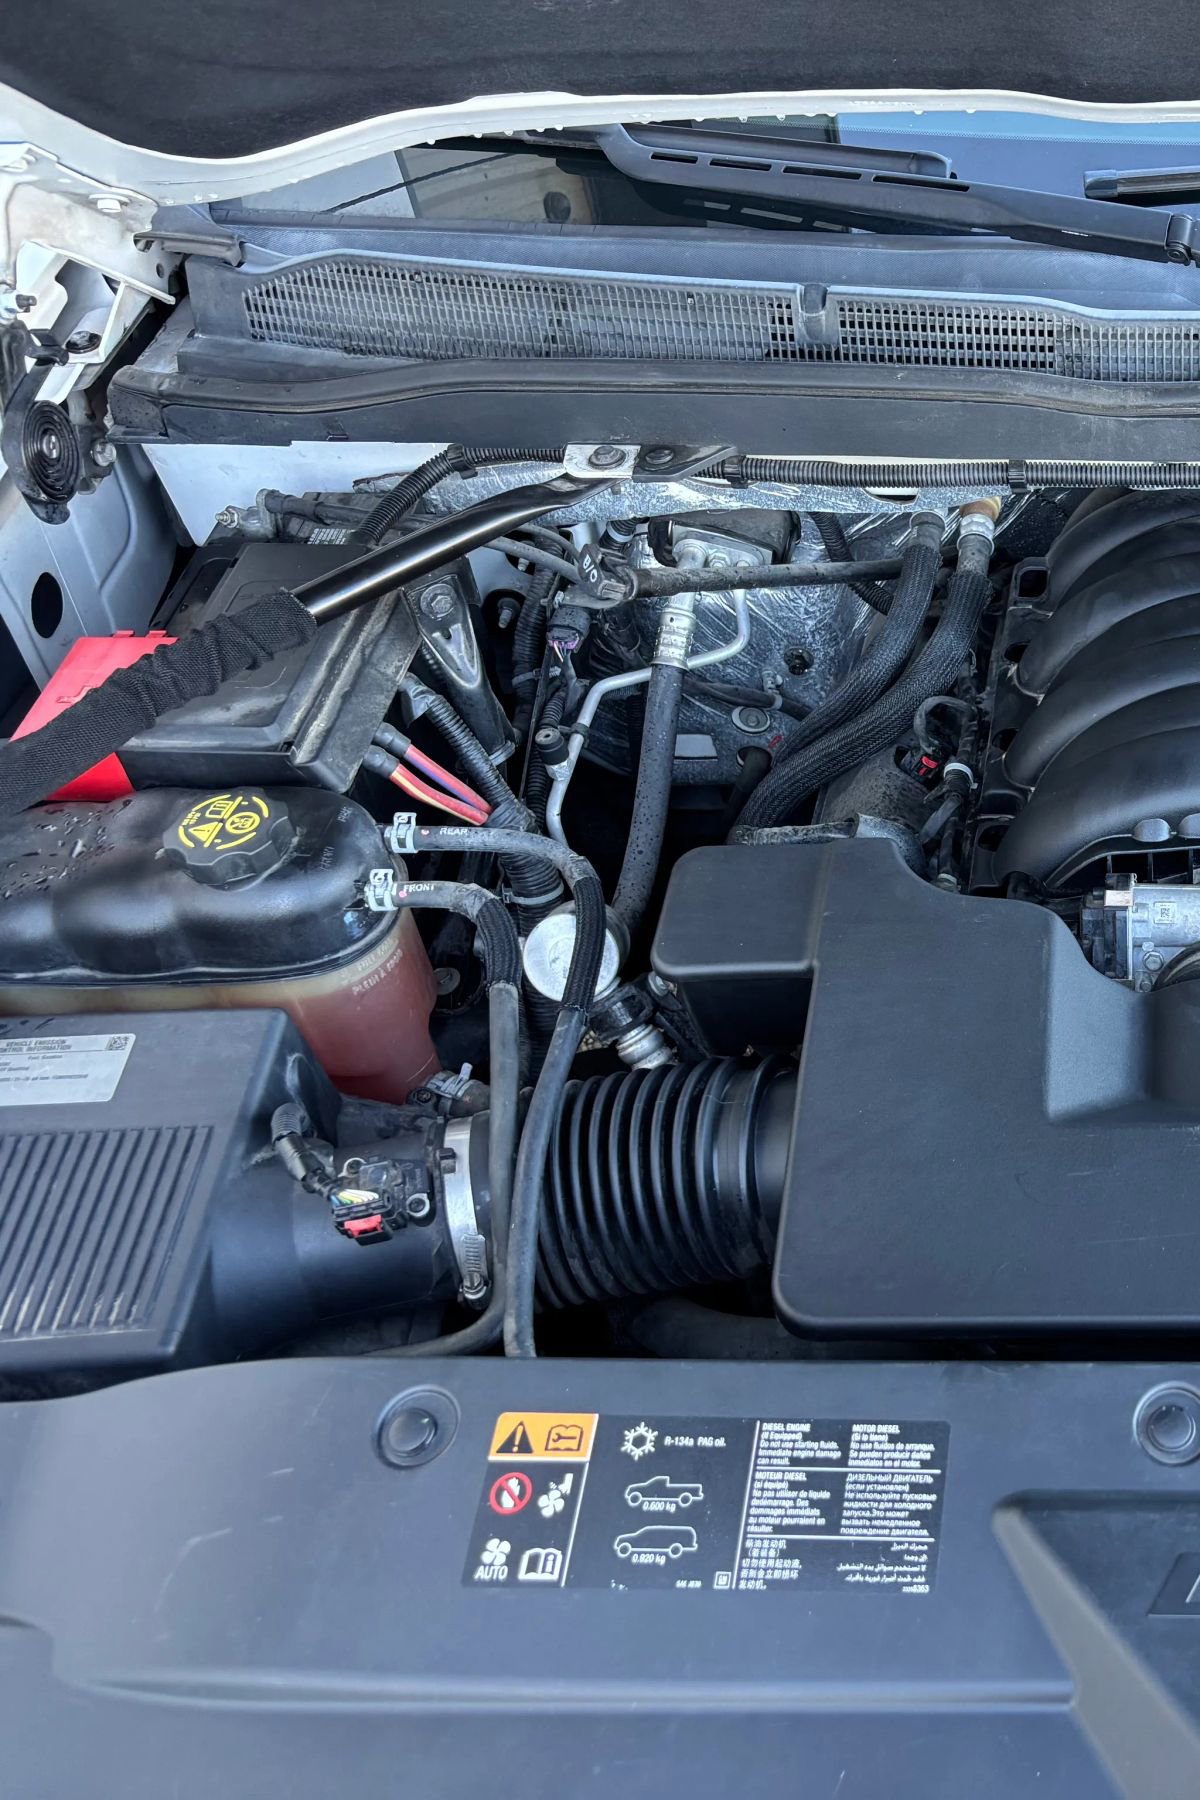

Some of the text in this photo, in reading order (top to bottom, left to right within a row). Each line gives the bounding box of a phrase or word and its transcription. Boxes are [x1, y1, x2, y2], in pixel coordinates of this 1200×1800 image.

[439, 827, 468, 835] REAR
[403, 882, 434, 892] FRONT
[762, 1423, 811, 1432] DIESEL ENGINE
[852, 1424, 900, 1434] MOTOR DIESEL
[664, 1436, 726, 1446] R-134a PAG oil.
[760, 1440, 769, 1448] Do
[781, 1441, 793, 1449] use
[795, 1441, 819, 1450] starting
[873, 1442, 895, 1450] fluidos
[793, 1450, 814, 1459] engine
[815, 1450, 841, 1459] damage
[849, 1450, 931, 1460] Se pueden producir daños
[848, 1459, 883, 1467] inmediatos
[755, 1472, 807, 1481] MOTEUR DIESEL
[846, 1473, 934, 1484] ДИЗЕЛЬНЫЙ ДВИГАТЕЛЬ
[845, 1482, 910, 1492] (если установлен)
[808, 1490, 830, 1499] liquide
[856, 1492, 900, 1500] используйте
[902, 1494, 937, 1502] пусковые
[666, 1502, 676, 1513] kg
[894, 1502, 933, 1510] холодного
[749, 1507, 820, 1516] dommages immédiats
[840, 1527, 890, 1535] повреждение
[655, 1554, 666, 1565] kg
[474, 1565, 508, 1580] AUTO
